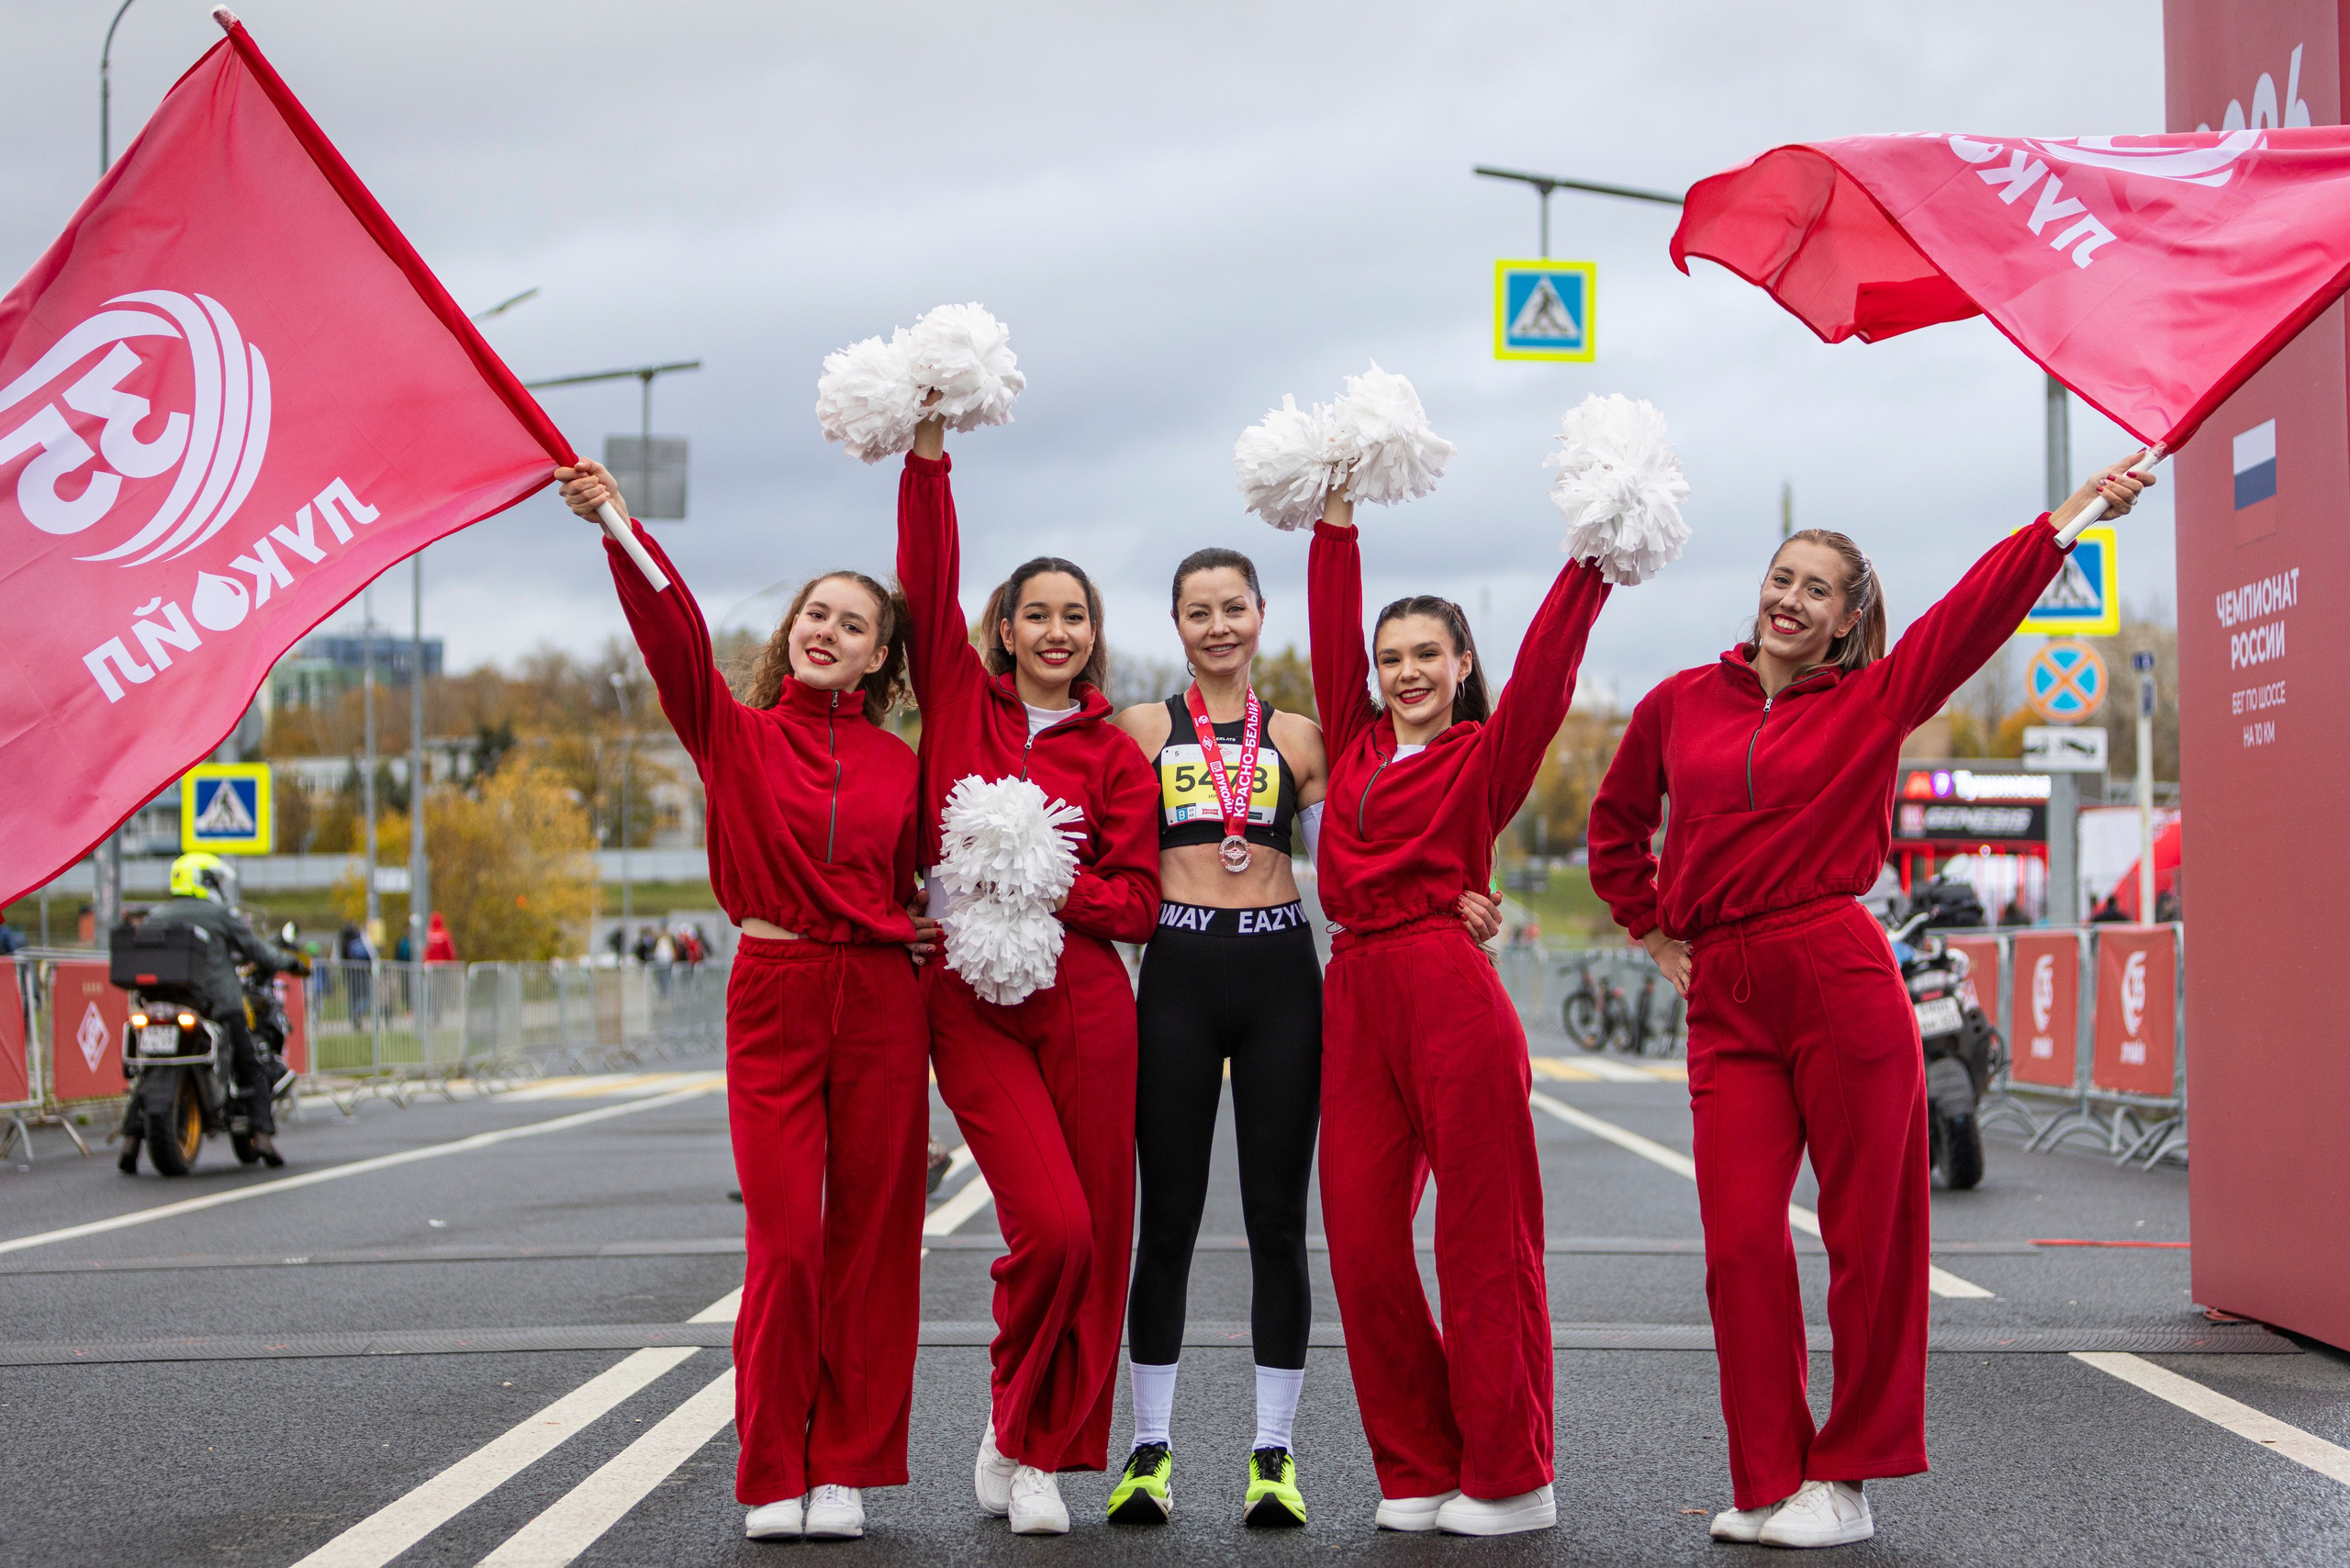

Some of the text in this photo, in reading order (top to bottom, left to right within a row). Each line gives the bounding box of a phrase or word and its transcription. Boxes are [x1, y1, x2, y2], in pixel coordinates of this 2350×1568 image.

[2216, 566, 2300, 629] ЧЕМПИОНАТ
[2231, 619, 2286, 671] РОССИИ
[2232, 679, 2287, 716] БЕГ ПО ШОССЕ
[2243, 724, 2255, 748] НА
[2264, 719, 2276, 744] КМ
[1233, 701, 1259, 817] КРАСНО-БЕЛЫЙ
[1159, 902, 1308, 934] WAY EAZYW
